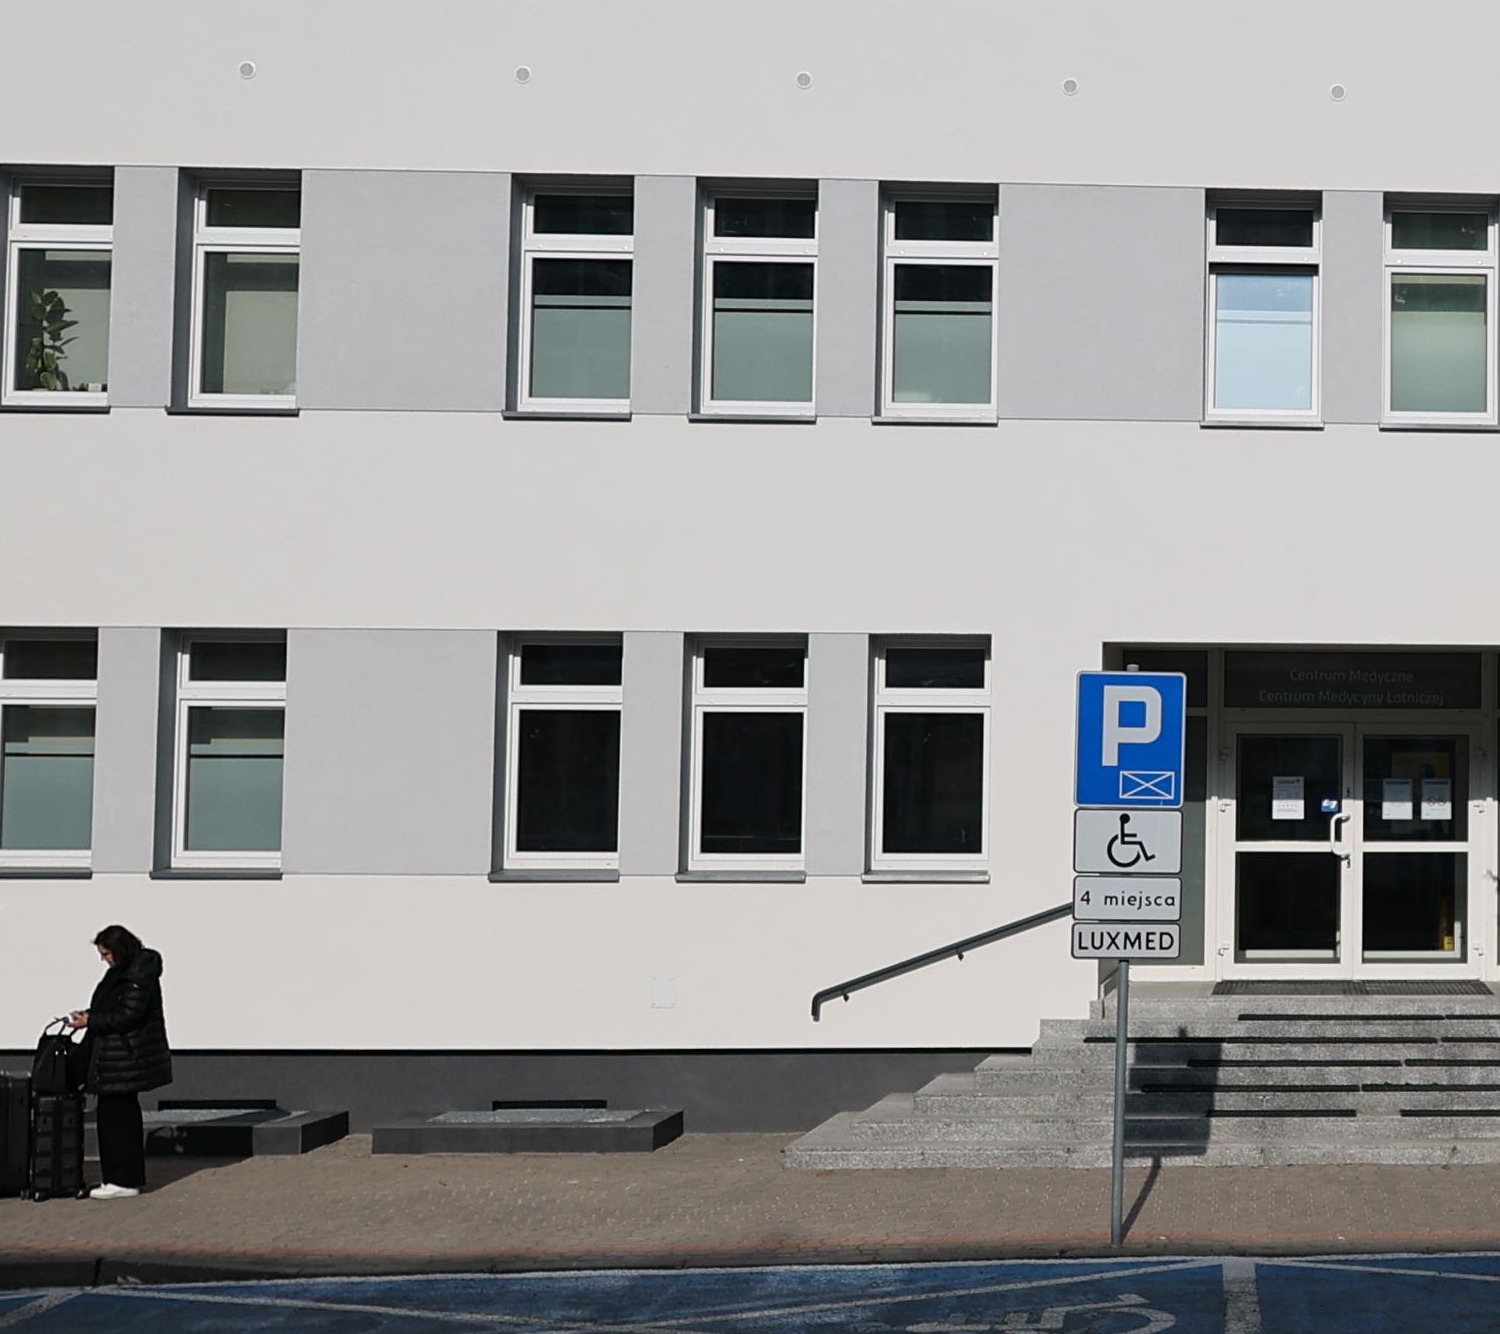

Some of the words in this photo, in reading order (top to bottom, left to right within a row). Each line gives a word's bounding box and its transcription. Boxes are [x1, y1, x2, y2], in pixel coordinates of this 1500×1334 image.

[1290, 669, 1346, 683] Centrum
[1349, 669, 1414, 687] Medyczne
[1259, 690, 1315, 703] Centrum
[1318, 690, 1384, 706] Medycyny
[1386, 690, 1444, 706] Lotniczej
[1101, 685, 1163, 766] P
[1080, 891, 1092, 906] 4
[1104, 888, 1176, 910] miejsca
[1078, 932, 1175, 951] LUXMED
